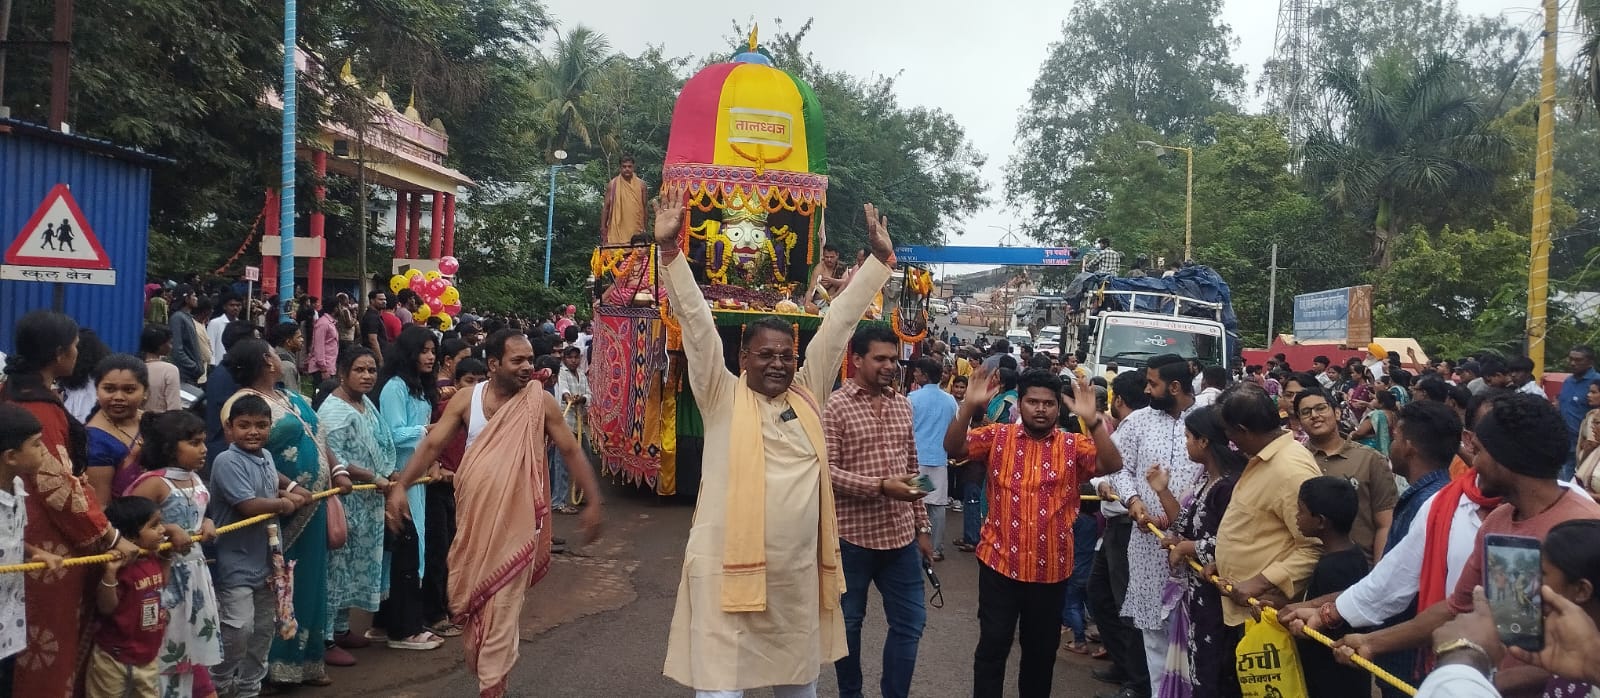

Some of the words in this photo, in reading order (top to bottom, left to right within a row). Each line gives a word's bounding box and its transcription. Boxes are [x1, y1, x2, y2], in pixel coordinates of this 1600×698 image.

[735, 119, 785, 135] तालध्वज
[19, 269, 60, 281] स्कूल
[66, 268, 92, 279] क्षेत्र
[1238, 643, 1281, 671] रुची
